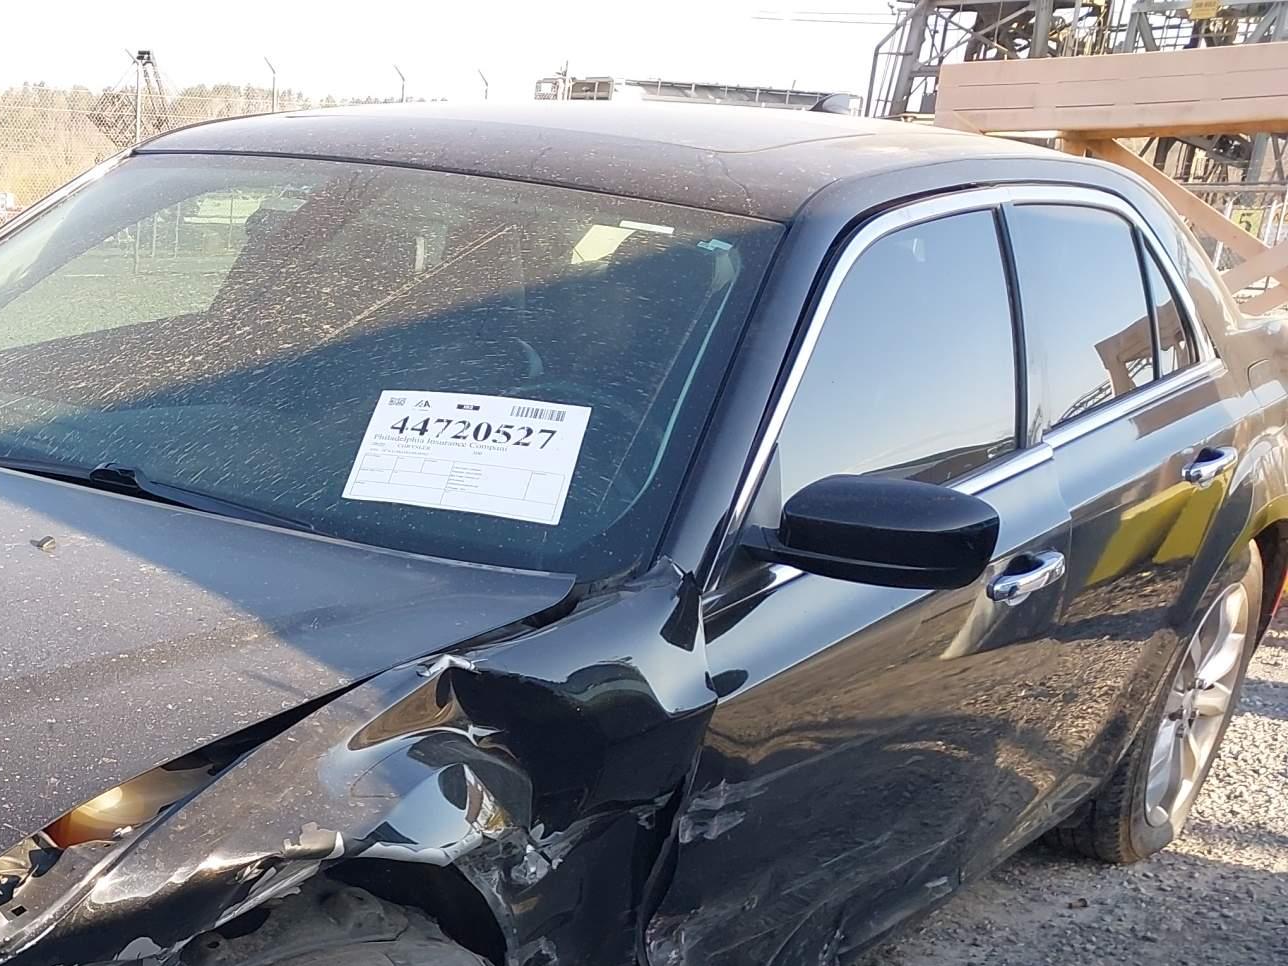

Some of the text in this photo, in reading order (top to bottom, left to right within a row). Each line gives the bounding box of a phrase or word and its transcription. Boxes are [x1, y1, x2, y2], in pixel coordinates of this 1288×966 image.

[1238, 212, 1254, 233] 5
[373, 433, 425, 445] Philadelphia
[427, 437, 467, 449] Insurance
[390, 415, 558, 449] 44720527
